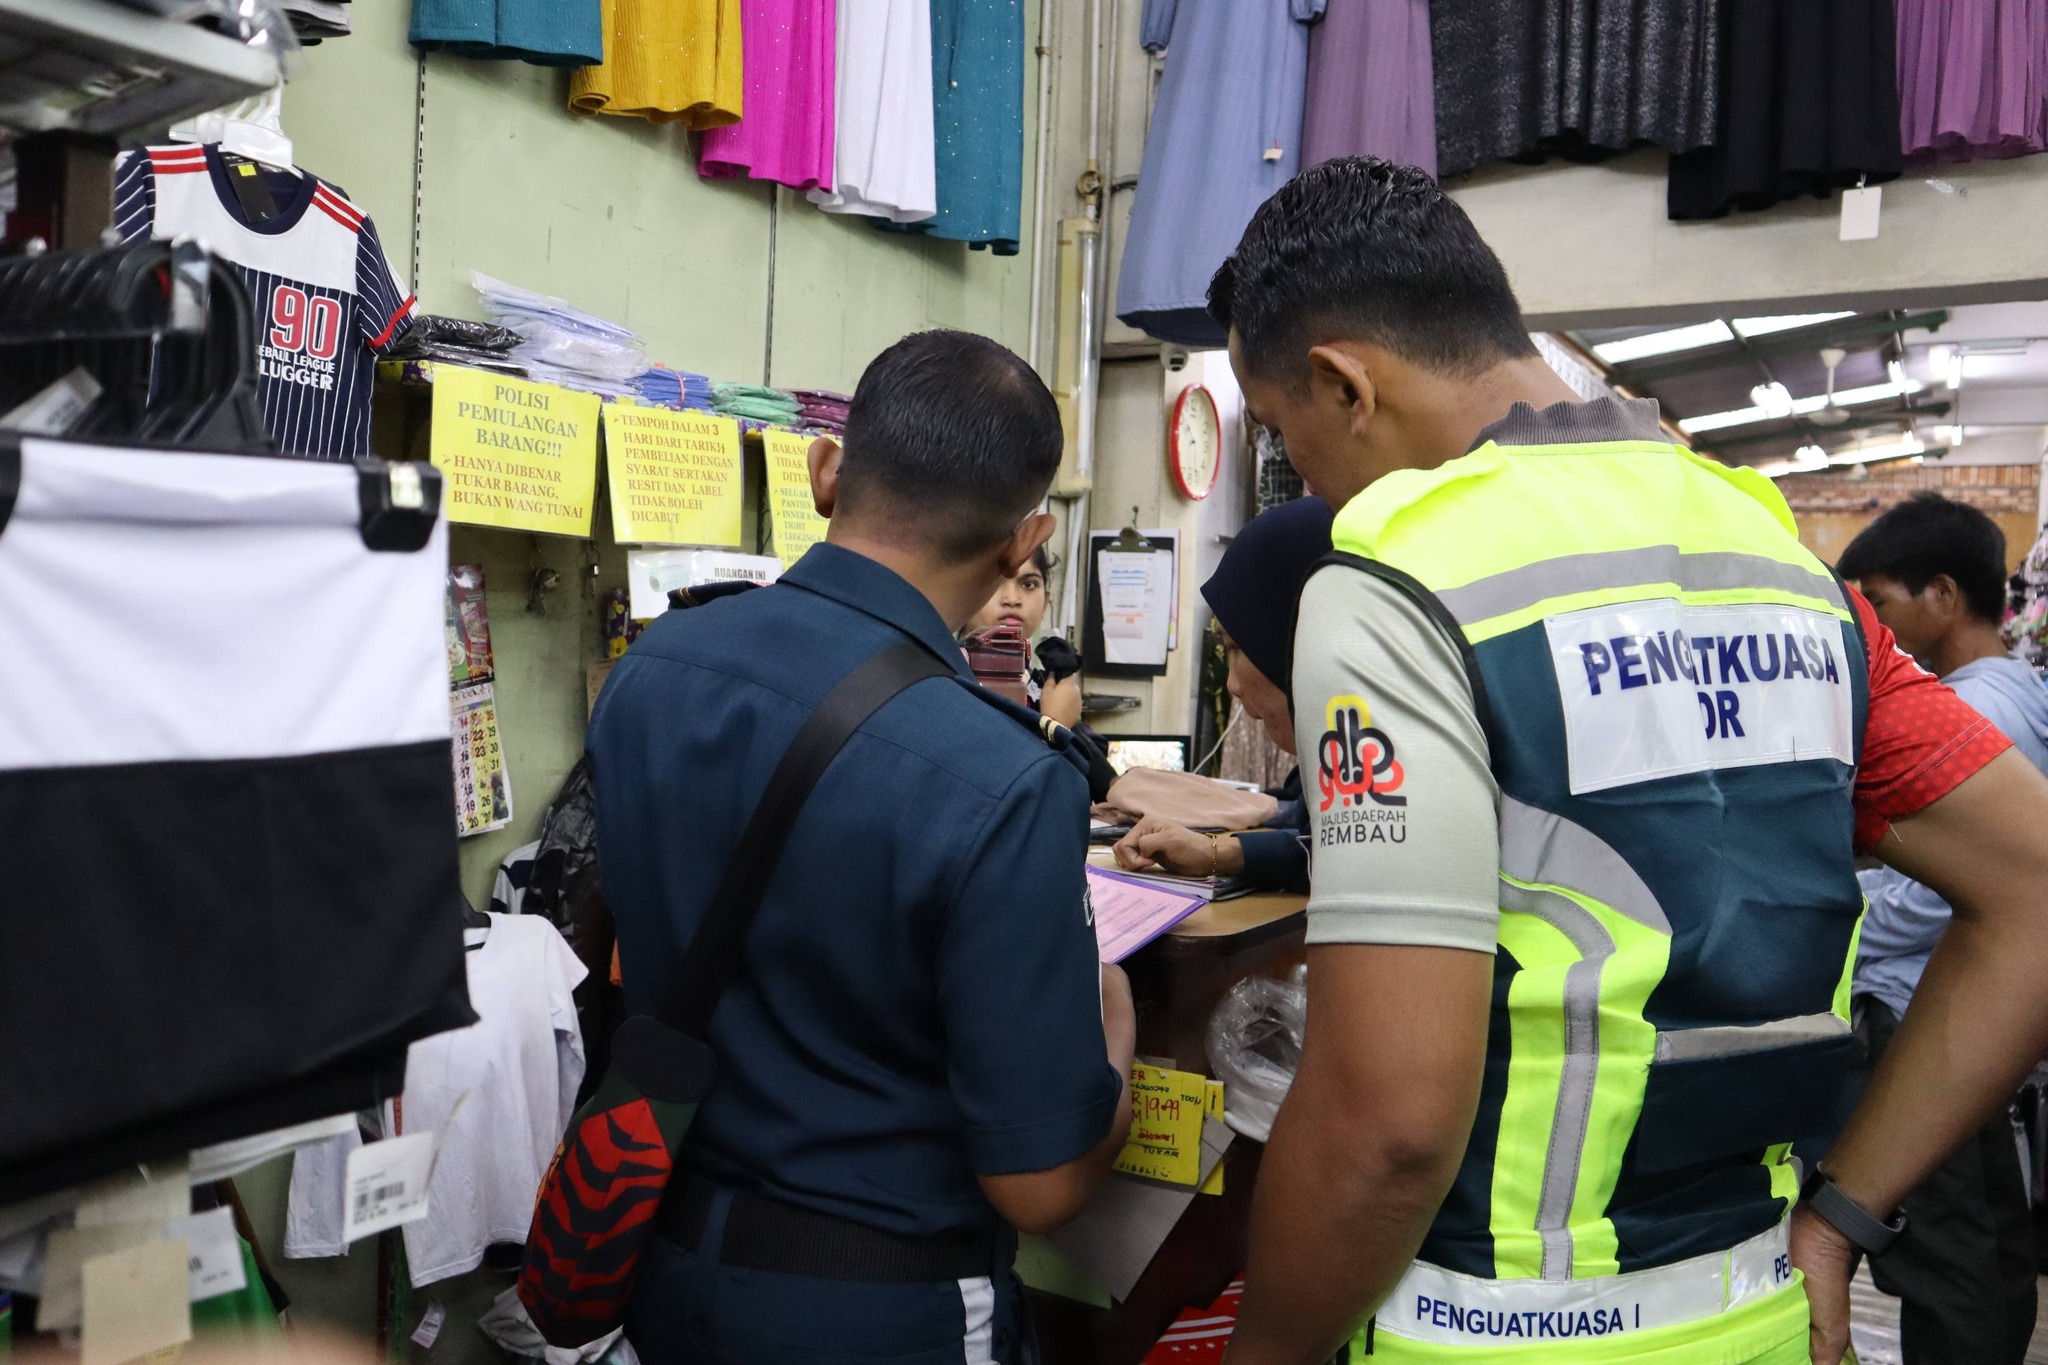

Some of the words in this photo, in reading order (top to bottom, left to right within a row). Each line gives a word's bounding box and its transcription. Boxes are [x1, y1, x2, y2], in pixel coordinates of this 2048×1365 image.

[270, 285, 342, 360] 90
[258, 345, 291, 363] EBALL
[294, 352, 336, 374] LEAGUE
[495, 385, 550, 411] POLISI
[457, 401, 579, 439] PEMULANGAN
[620, 415, 669, 430] TEMPOH
[671, 421, 710, 435] DALAM
[712, 424, 719, 436] 3
[476, 428, 562, 458] BARANG!!!
[623, 432, 653, 445] HARI
[656, 435, 681, 448] DARI
[683, 439, 725, 454] TARIKH
[625, 448, 689, 464] PEMBELIAN
[692, 454, 734, 468] DENGAN
[775, 457, 804, 470] TIDAK
[453, 455, 503, 474] HANYA
[506, 463, 562, 483] DIBENAR
[626, 463, 669, 477] SYARAT
[673, 468, 728, 482] SERTAKAN
[453, 473, 501, 490] TUKAR
[504, 480, 559, 499] BARANG,
[628, 479, 661, 491] RESIT
[664, 482, 686, 494] DAN
[692, 484, 724, 497] LABEL
[453, 491, 501, 508] BUKAN
[504, 498, 543, 513] WANG
[546, 503, 584, 519] TUNAI
[629, 495, 666, 508] TIDAK
[668, 497, 703, 510] BOLEH
[781, 499, 812, 509] PANTIES
[631, 511, 680, 524] DICABUT
[784, 521, 806, 531] TIGHT
[714, 567, 754, 580] RUANGAN
[755, 571, 766, 581] INI
[473, 730, 484, 741] 22
[475, 746, 486, 757] 23
[490, 743, 498, 753] 30
[491, 759, 499, 769] 31
[481, 795, 491, 807] 26
[469, 816, 479, 829] 20
[1321, 811, 1350, 827] MAJLIS
[1352, 810, 1406, 823] DAERAH
[1320, 824, 1406, 848] REMBAU
[1145, 1095, 1179, 1121] 19.99
[1774, 1253, 1792, 1283] PE
[1416, 1294, 1624, 1338] PENGUATKUASA
